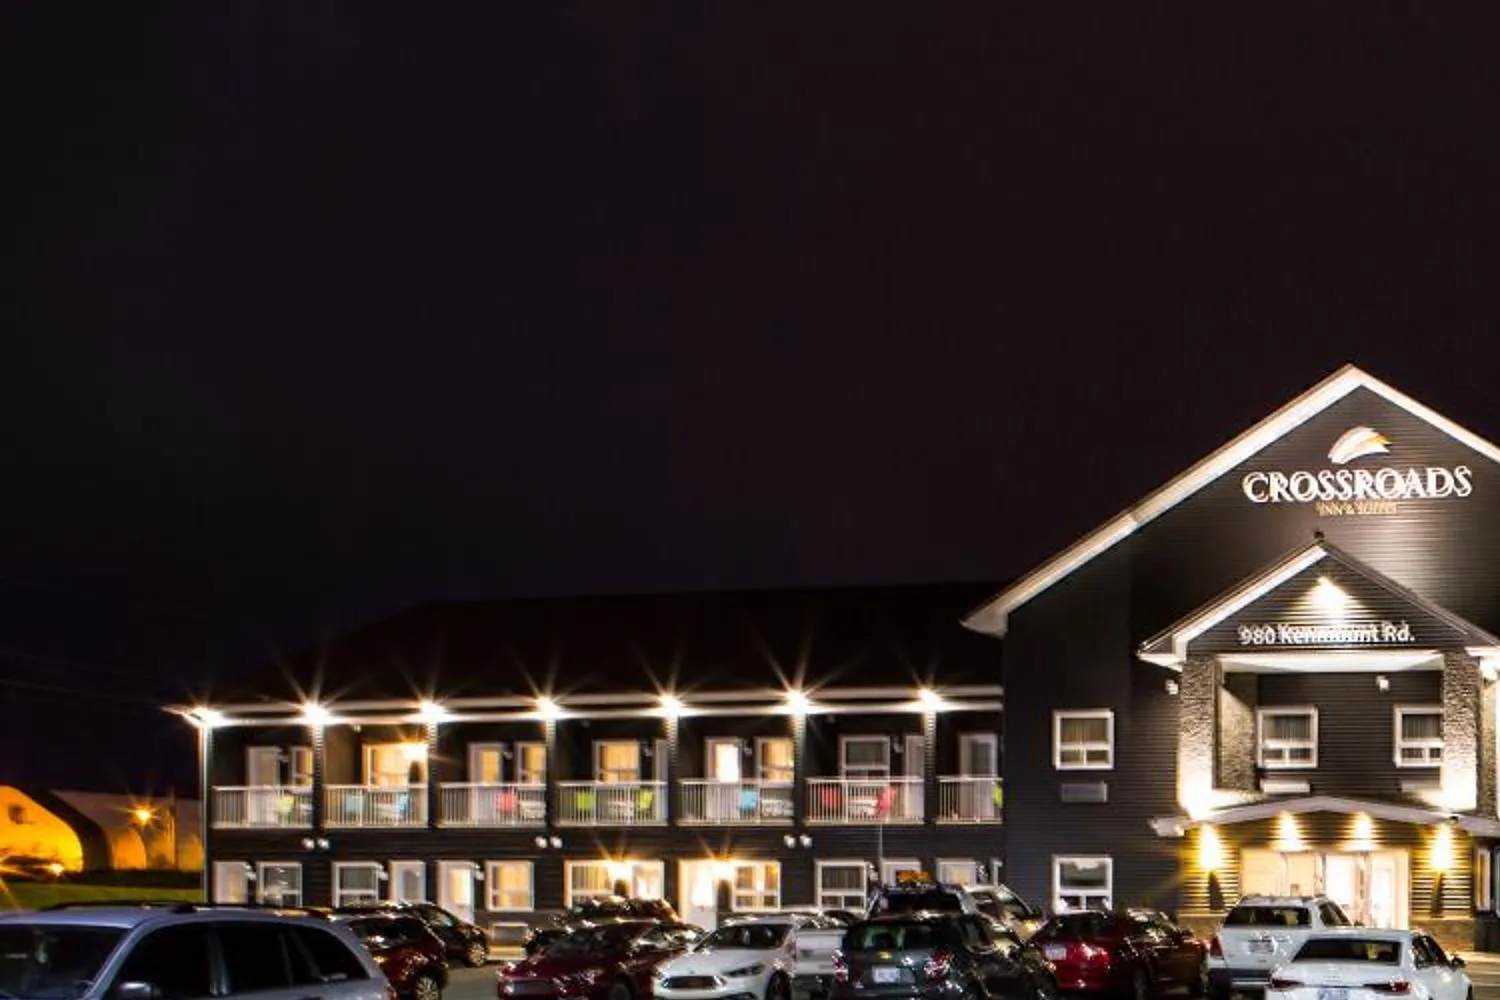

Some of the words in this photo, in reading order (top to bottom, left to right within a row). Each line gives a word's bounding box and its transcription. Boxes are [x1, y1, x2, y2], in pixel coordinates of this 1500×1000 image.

[1242, 465, 1473, 502] CROSSROADS
[1238, 623, 1276, 645] 980
[1381, 620, 1415, 643] Rd.
